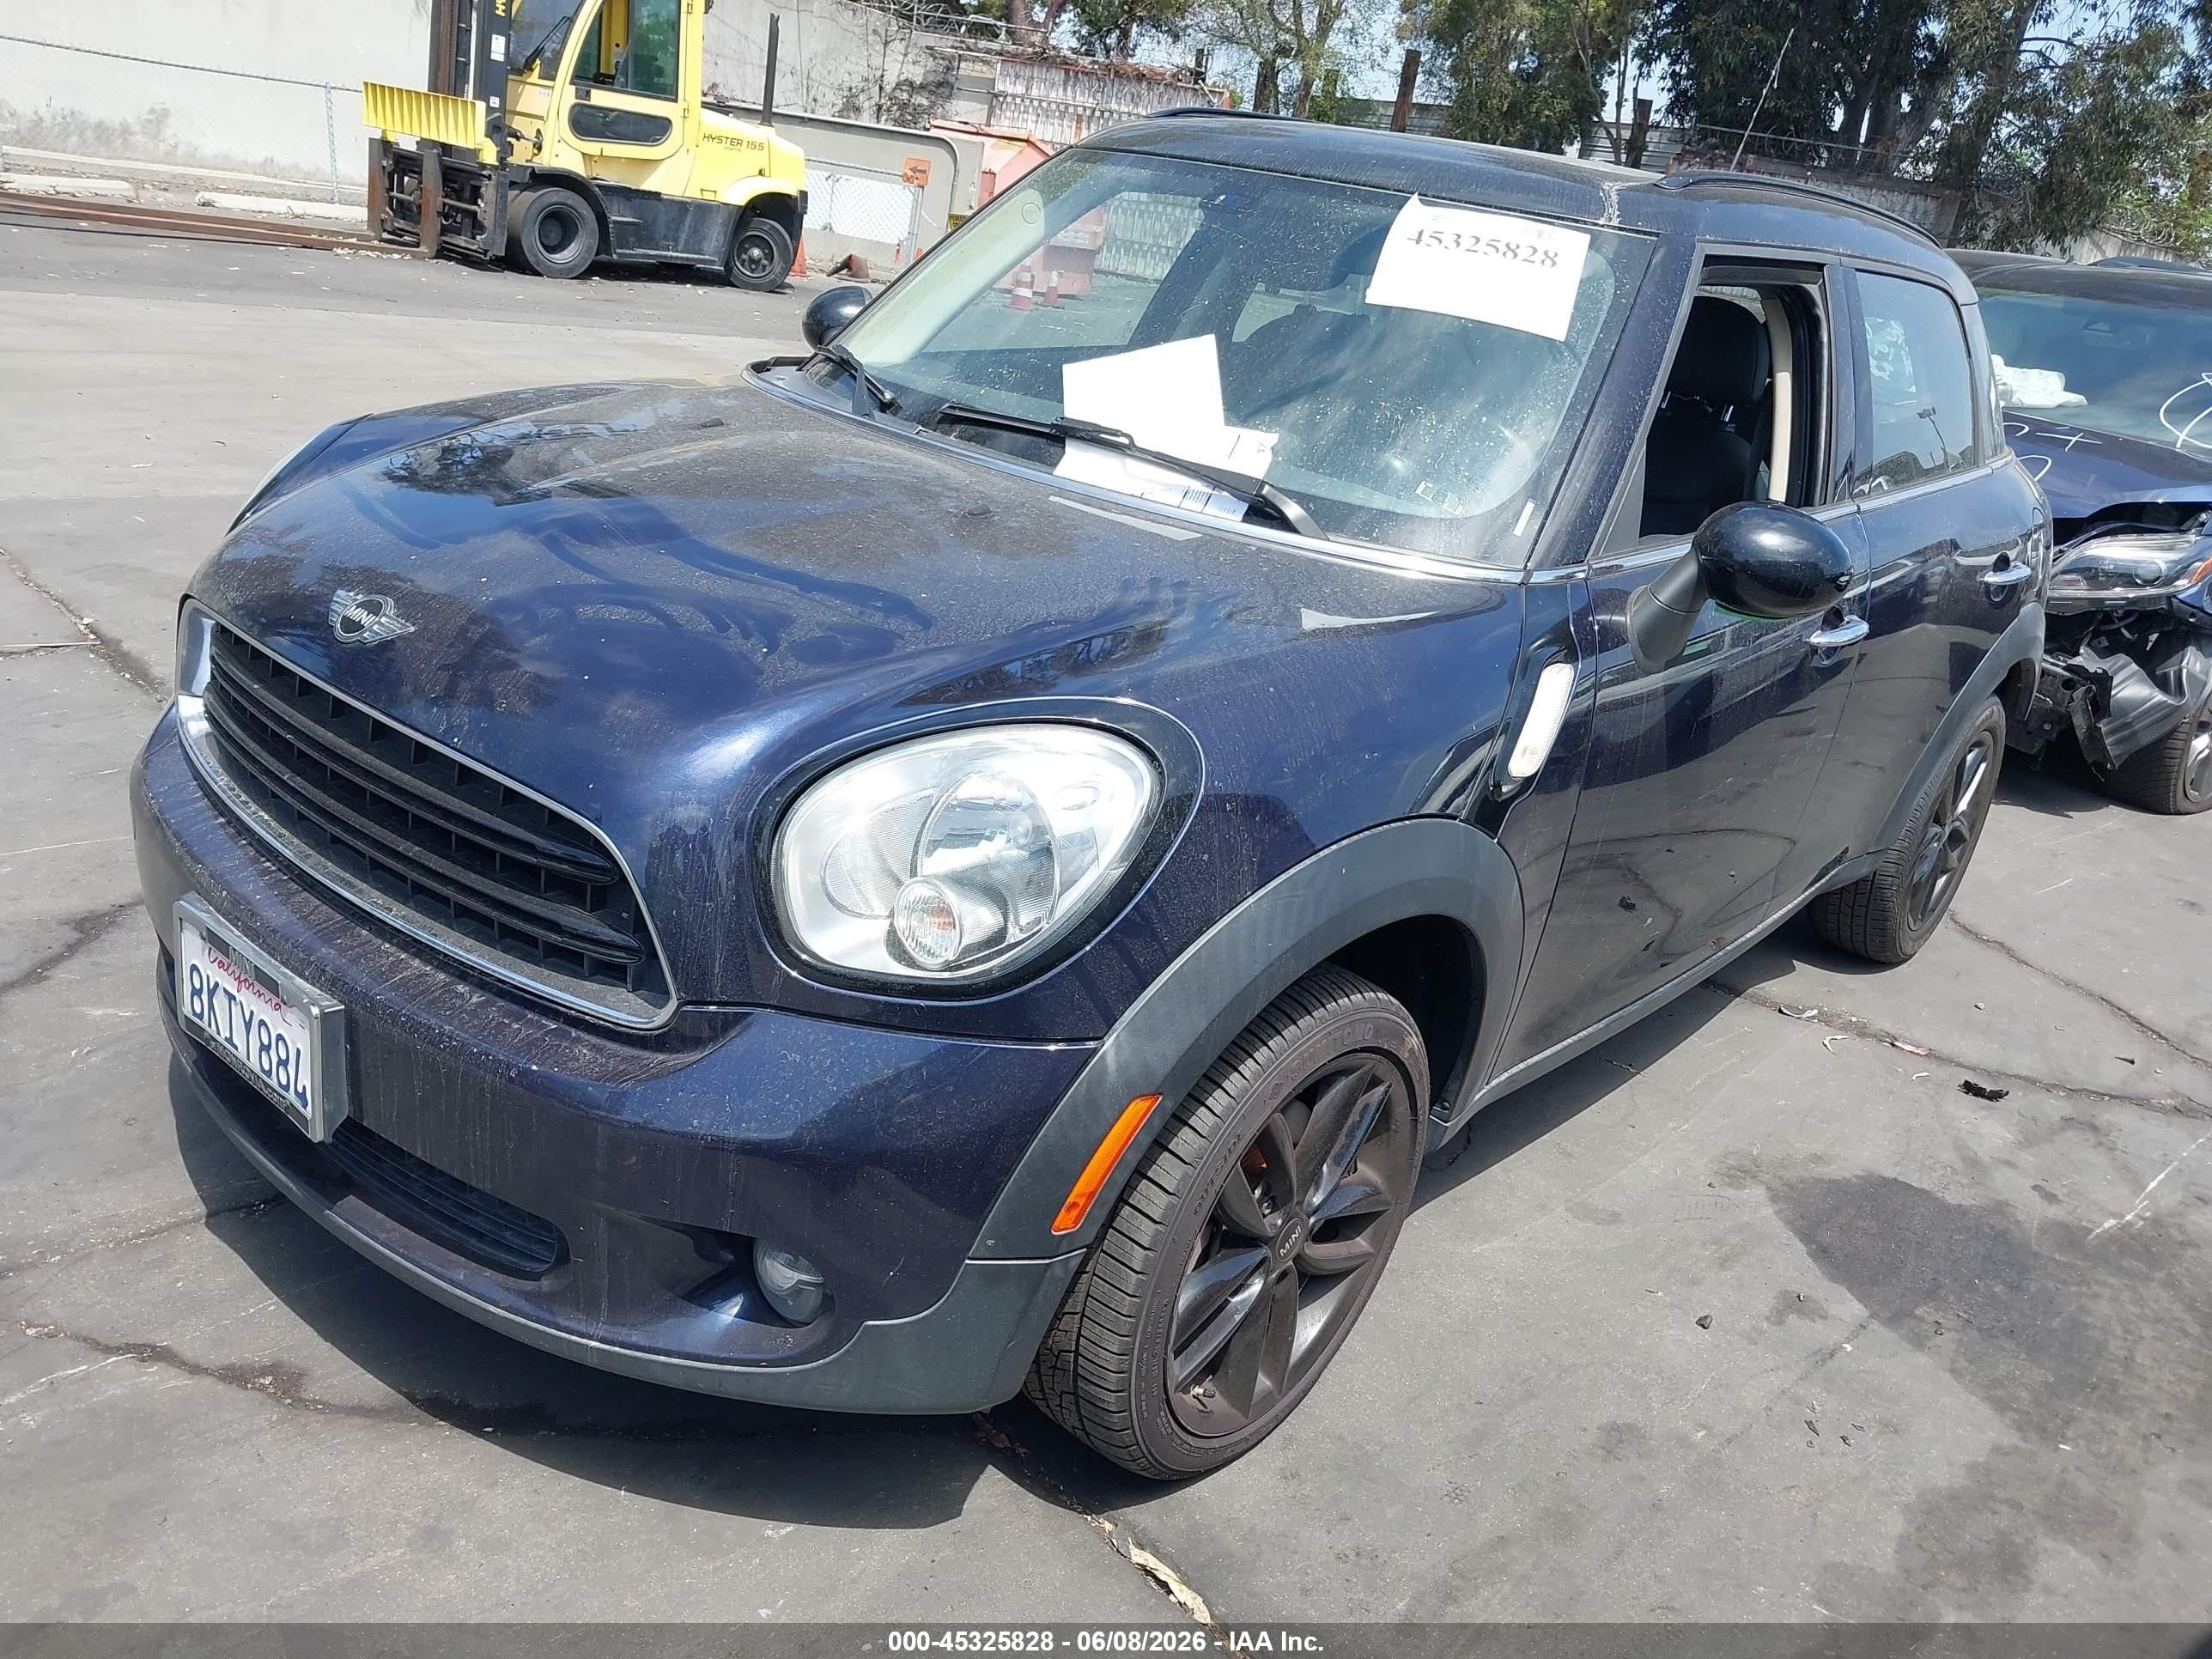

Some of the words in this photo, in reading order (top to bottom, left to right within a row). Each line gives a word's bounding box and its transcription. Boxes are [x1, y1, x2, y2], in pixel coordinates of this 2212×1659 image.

[702, 133, 744, 148] HYSTER
[746, 140, 765, 151] 155
[1407, 228, 1559, 268] 45325828
[344, 605, 376, 628] MINI
[207, 945, 289, 1022] California
[189, 963, 308, 1110] 8KIY884
[1279, 1224, 1301, 1257] MINI
